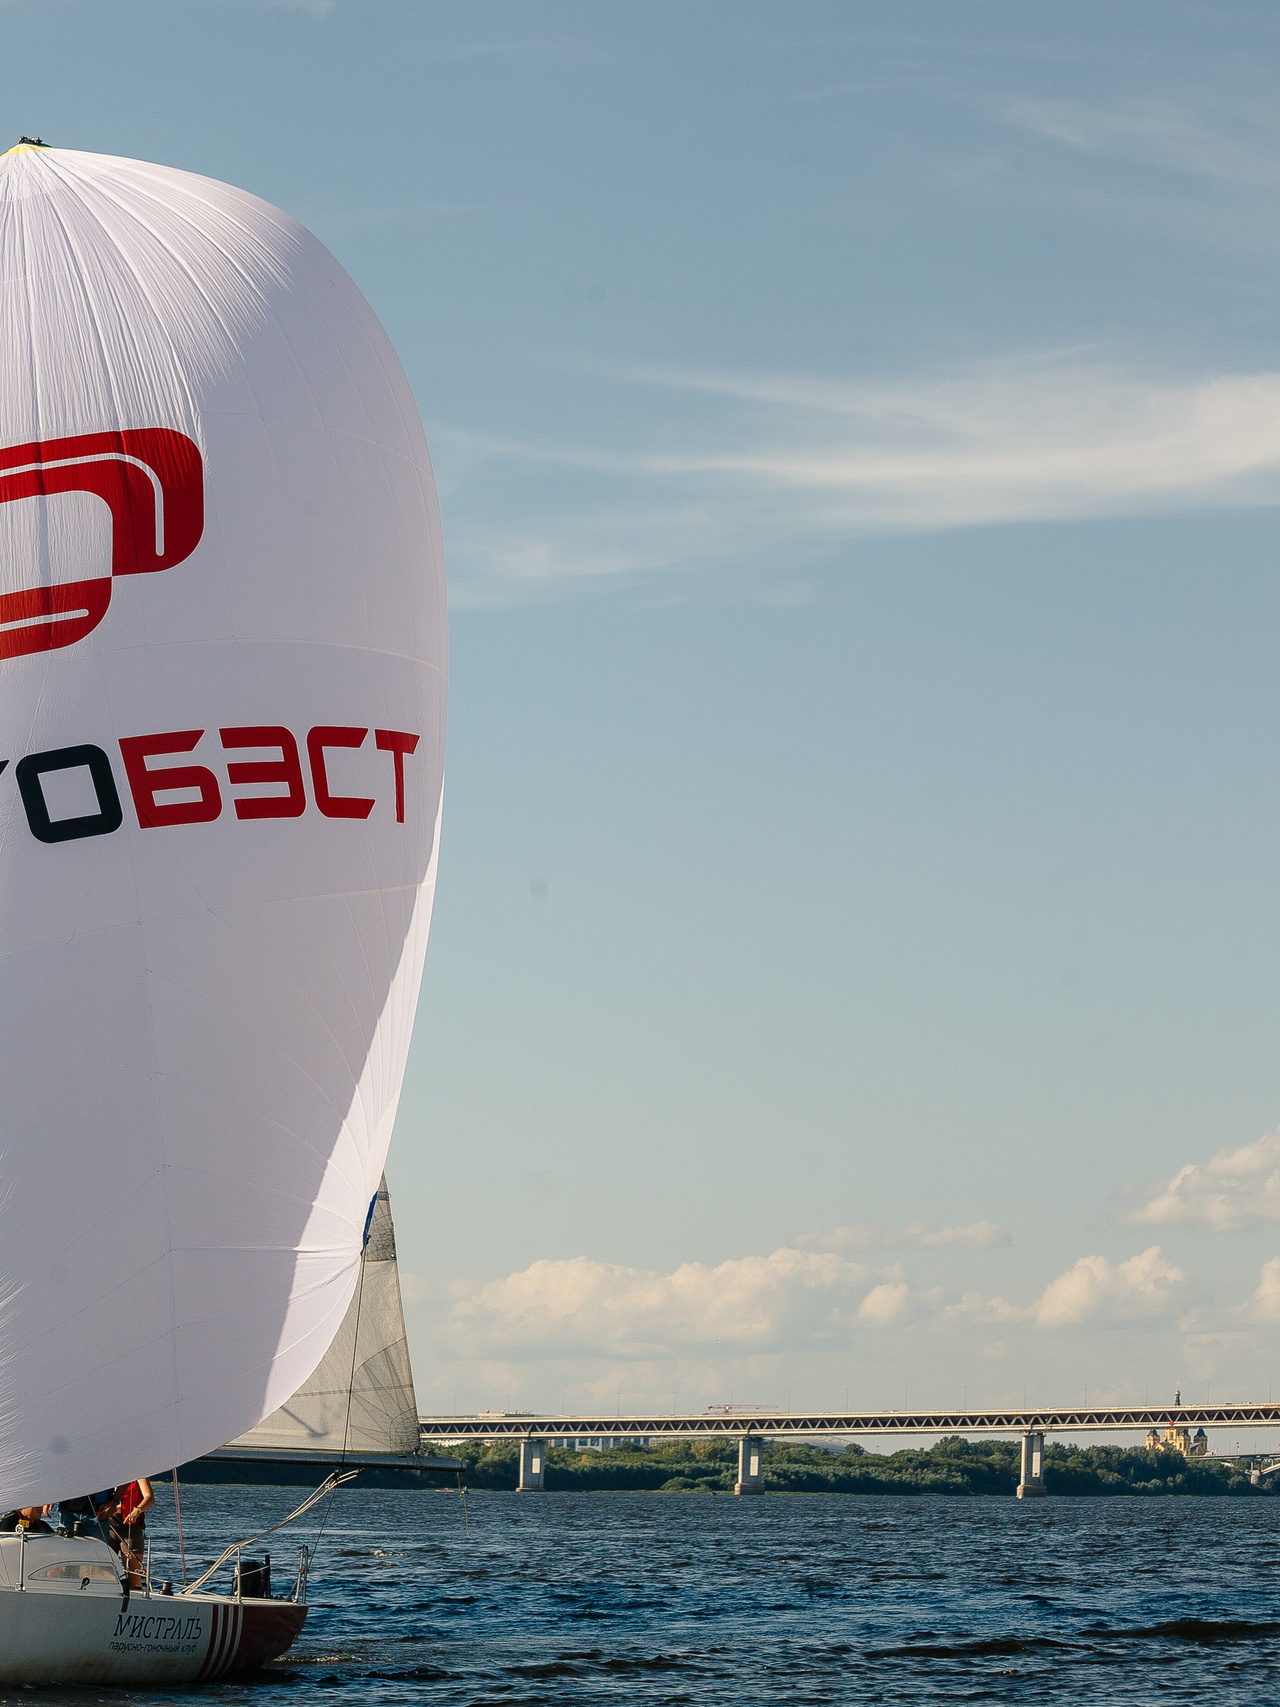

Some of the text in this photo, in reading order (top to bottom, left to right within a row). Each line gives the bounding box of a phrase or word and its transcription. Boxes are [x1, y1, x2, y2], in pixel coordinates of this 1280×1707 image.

[113, 1614, 202, 1640] МИСТРАЛЬ
[108, 1641, 198, 1655] парусно-гоночный клуб
